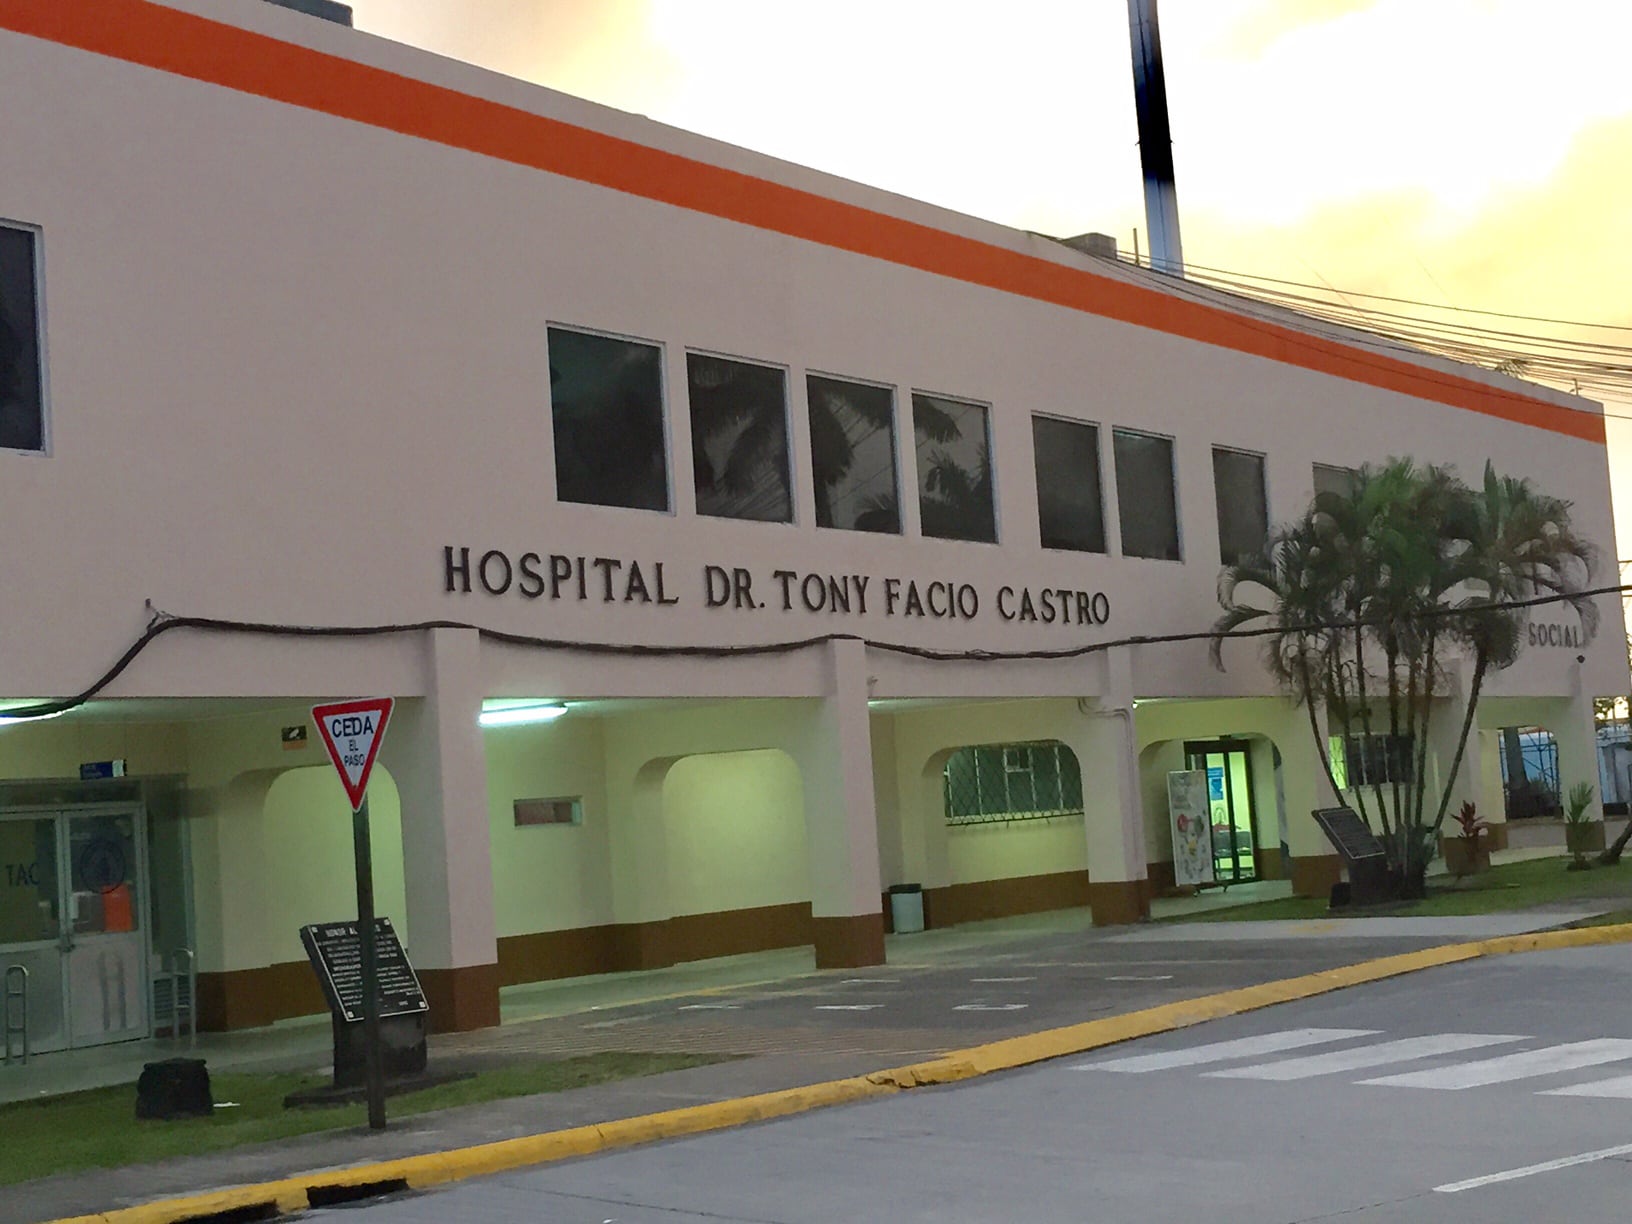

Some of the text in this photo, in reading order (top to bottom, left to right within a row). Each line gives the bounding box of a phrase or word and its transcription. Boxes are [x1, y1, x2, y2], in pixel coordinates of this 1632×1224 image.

[444, 546, 1110, 625] HOSPITAL DR. TONY FACIO CASTRO
[1528, 622, 1583, 648] SOCIAL
[332, 716, 374, 738] CEDA
[348, 739, 359, 752] EL
[344, 754, 365, 767] PASO
[5, 863, 41, 886] TAC
